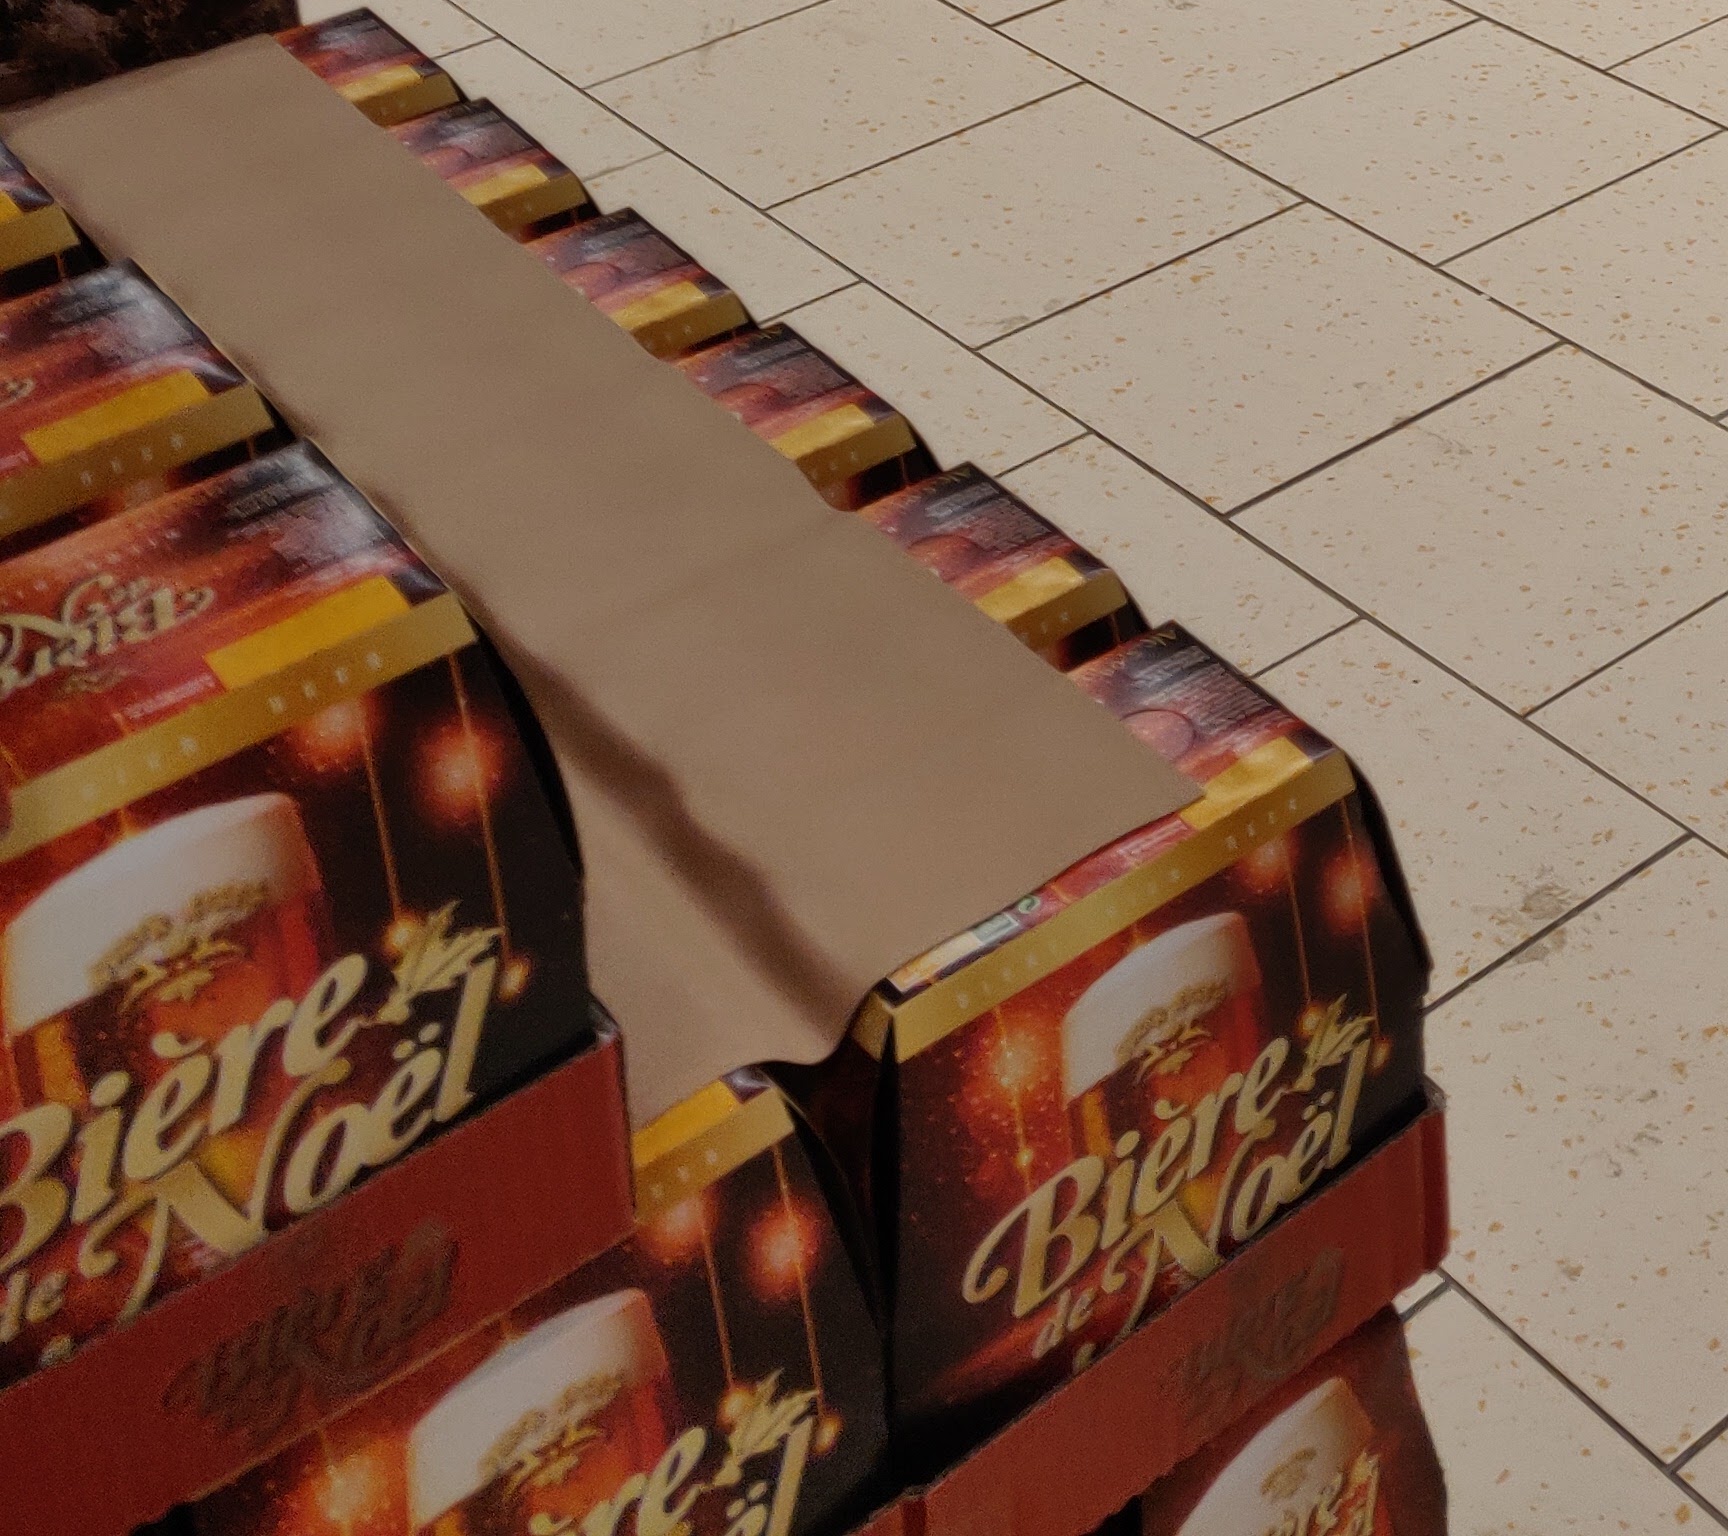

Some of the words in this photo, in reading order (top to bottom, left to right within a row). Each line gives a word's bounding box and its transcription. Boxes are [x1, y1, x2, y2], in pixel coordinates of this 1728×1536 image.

[962, 1037, 1291, 1318] Bière
[1100, 1039, 1373, 1342] Noël
[1031, 1284, 1096, 1361] de
